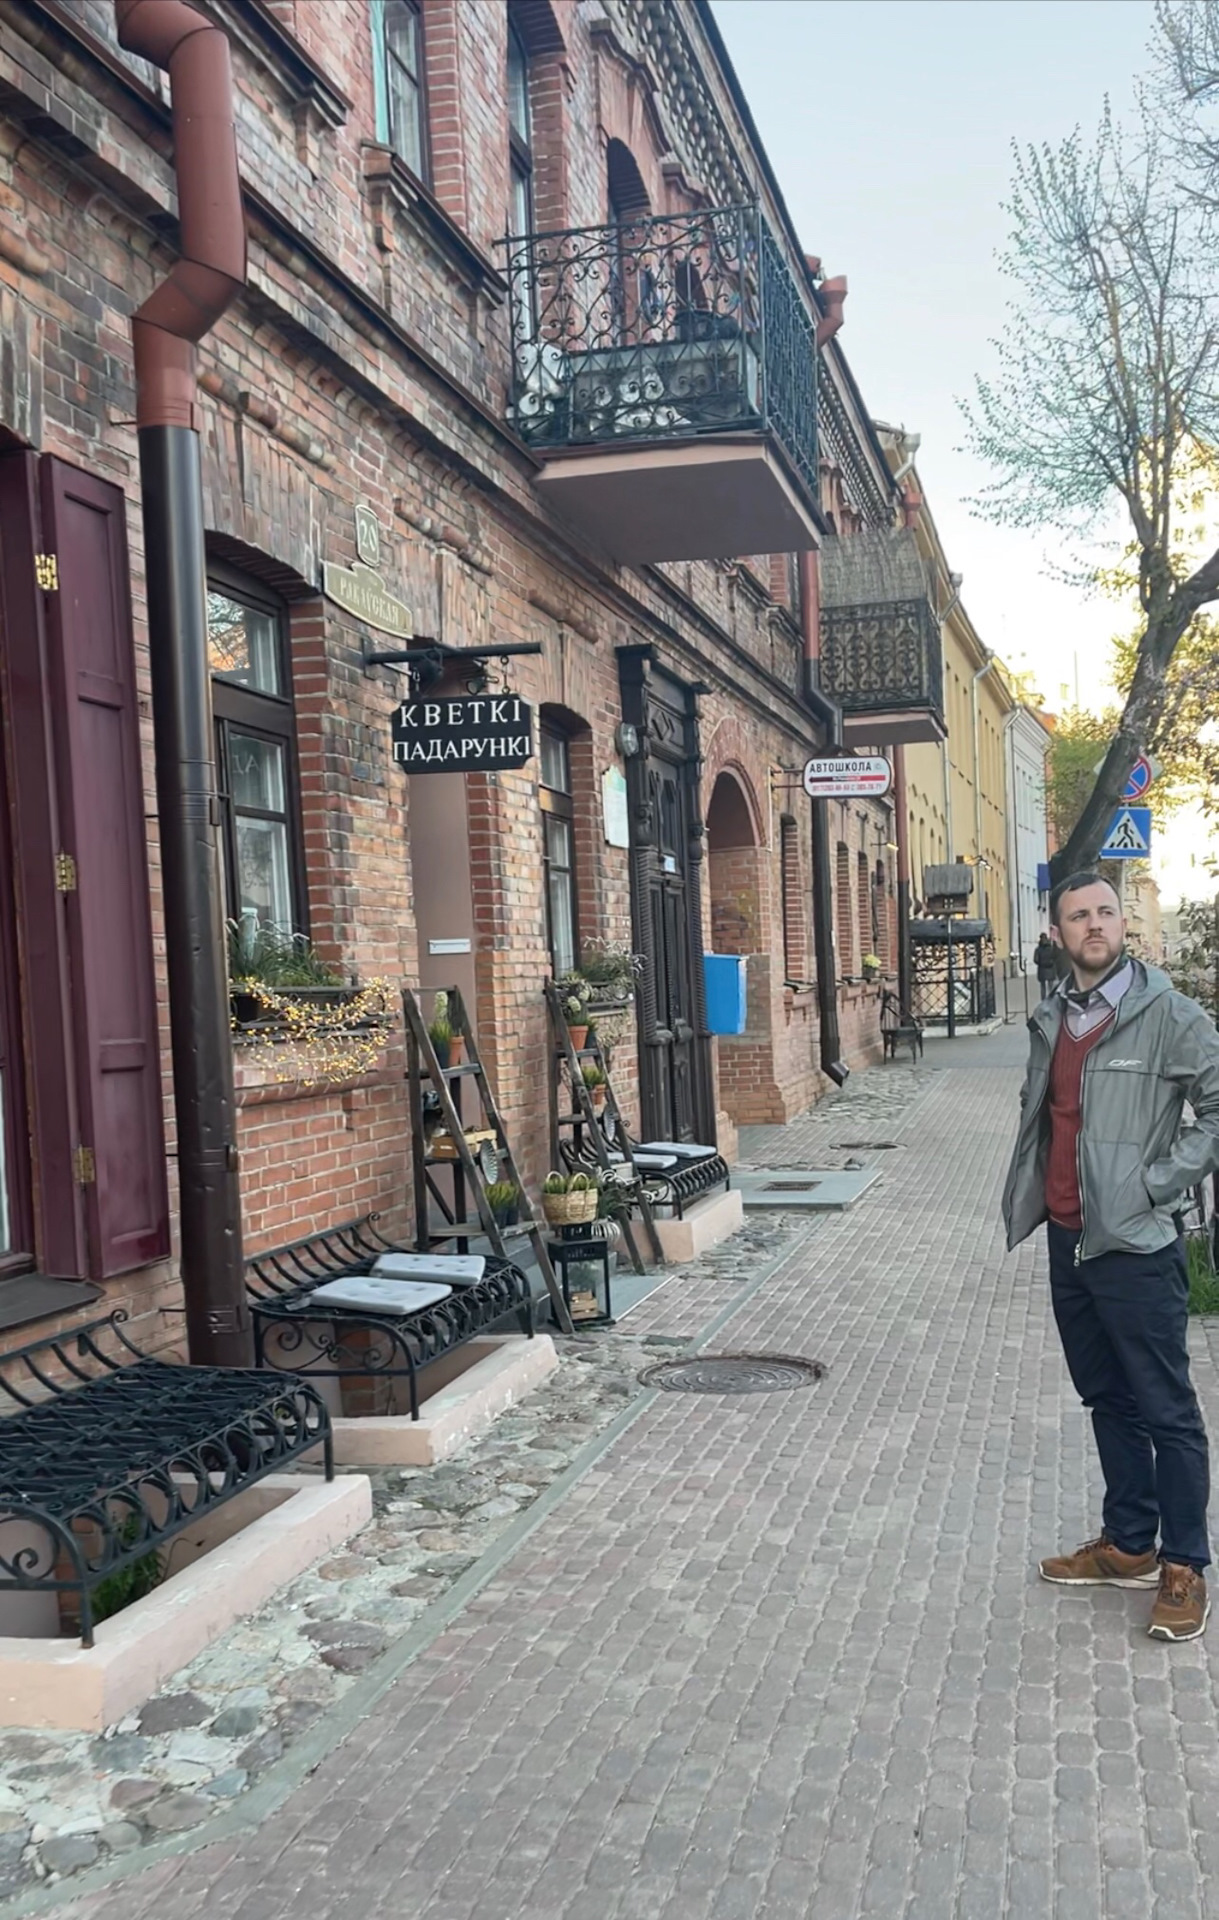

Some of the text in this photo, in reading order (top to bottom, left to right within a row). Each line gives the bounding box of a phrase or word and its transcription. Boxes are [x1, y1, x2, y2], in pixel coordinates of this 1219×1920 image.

[400, 699, 521, 728] КВЕТКІ
[393, 736, 530, 763] ПАДАРУНКІ
[810, 762, 872, 773] АВТОШКОЛА
